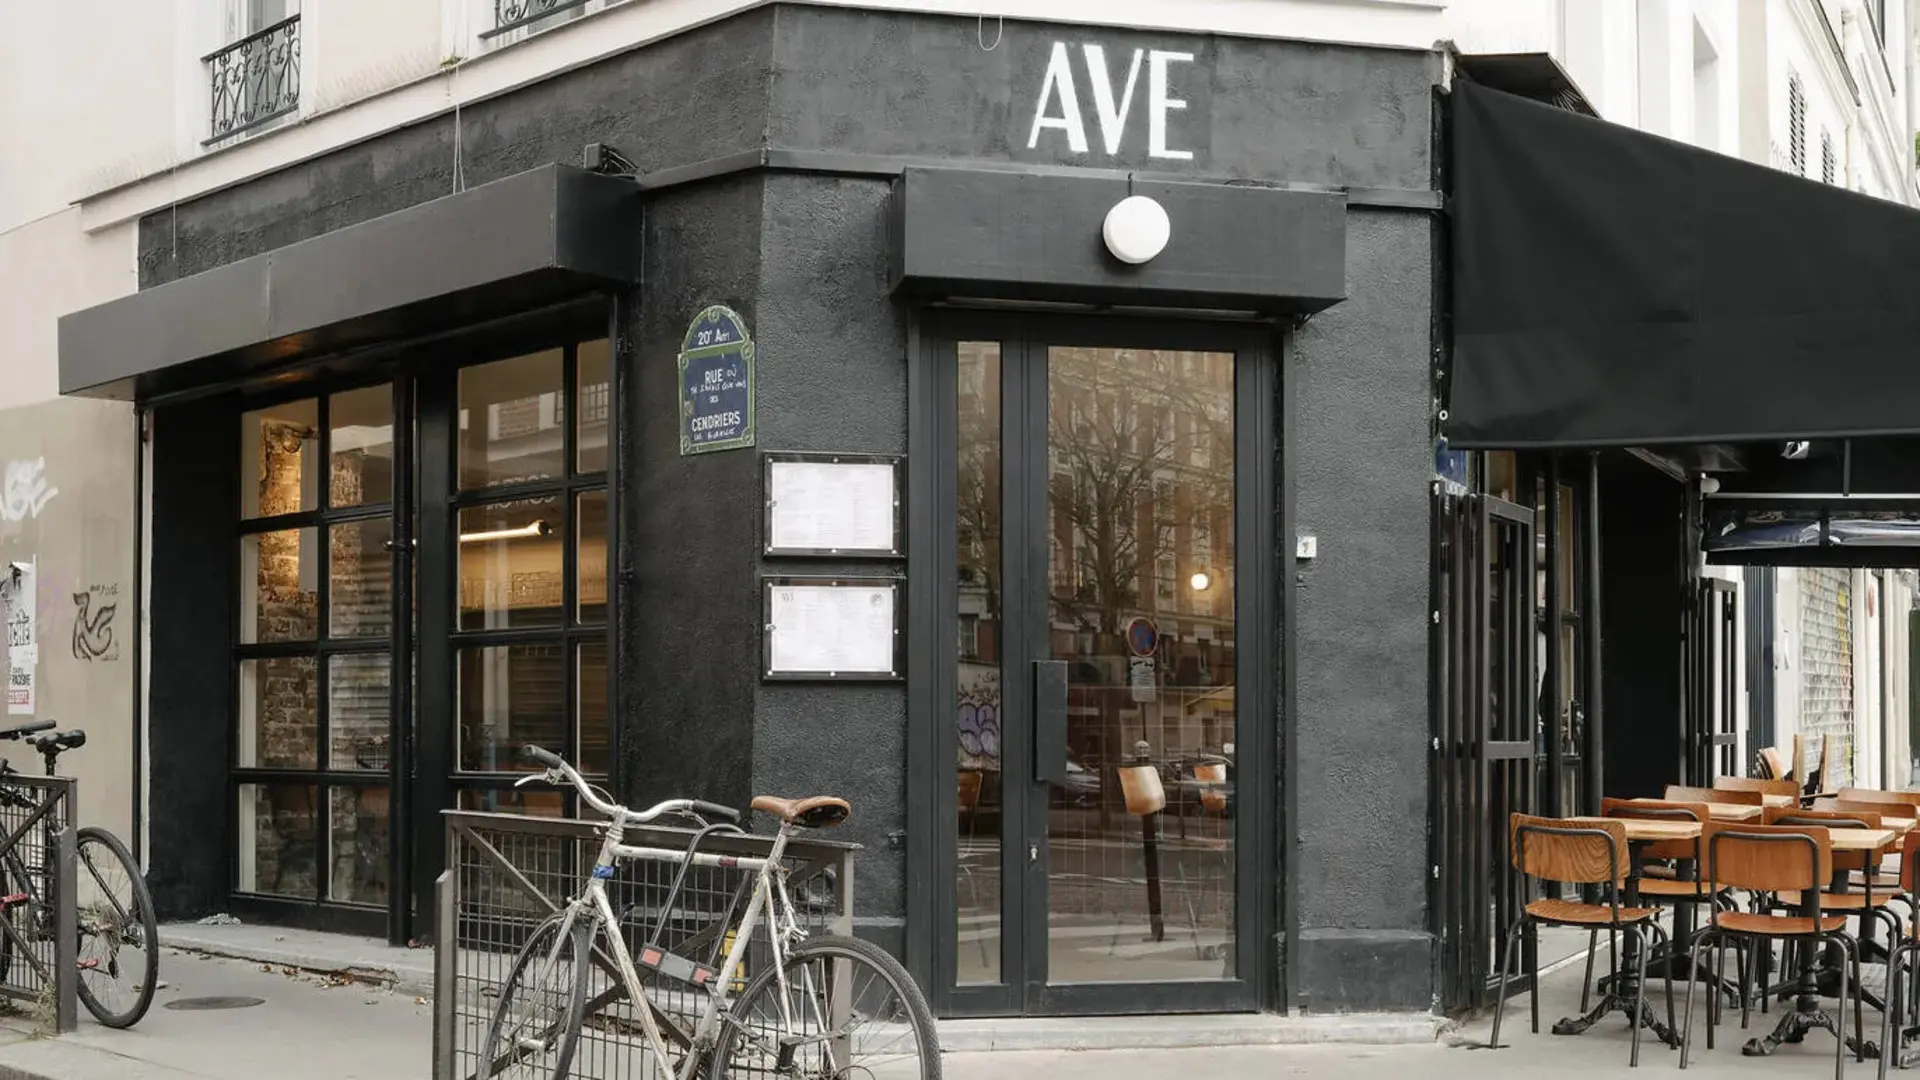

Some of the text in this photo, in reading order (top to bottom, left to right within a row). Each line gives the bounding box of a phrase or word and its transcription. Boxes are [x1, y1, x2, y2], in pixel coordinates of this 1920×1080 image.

[1027, 41, 1194, 159] AVE
[704, 368, 722, 383] RUE
[692, 411, 741, 432] CENDRIERS
